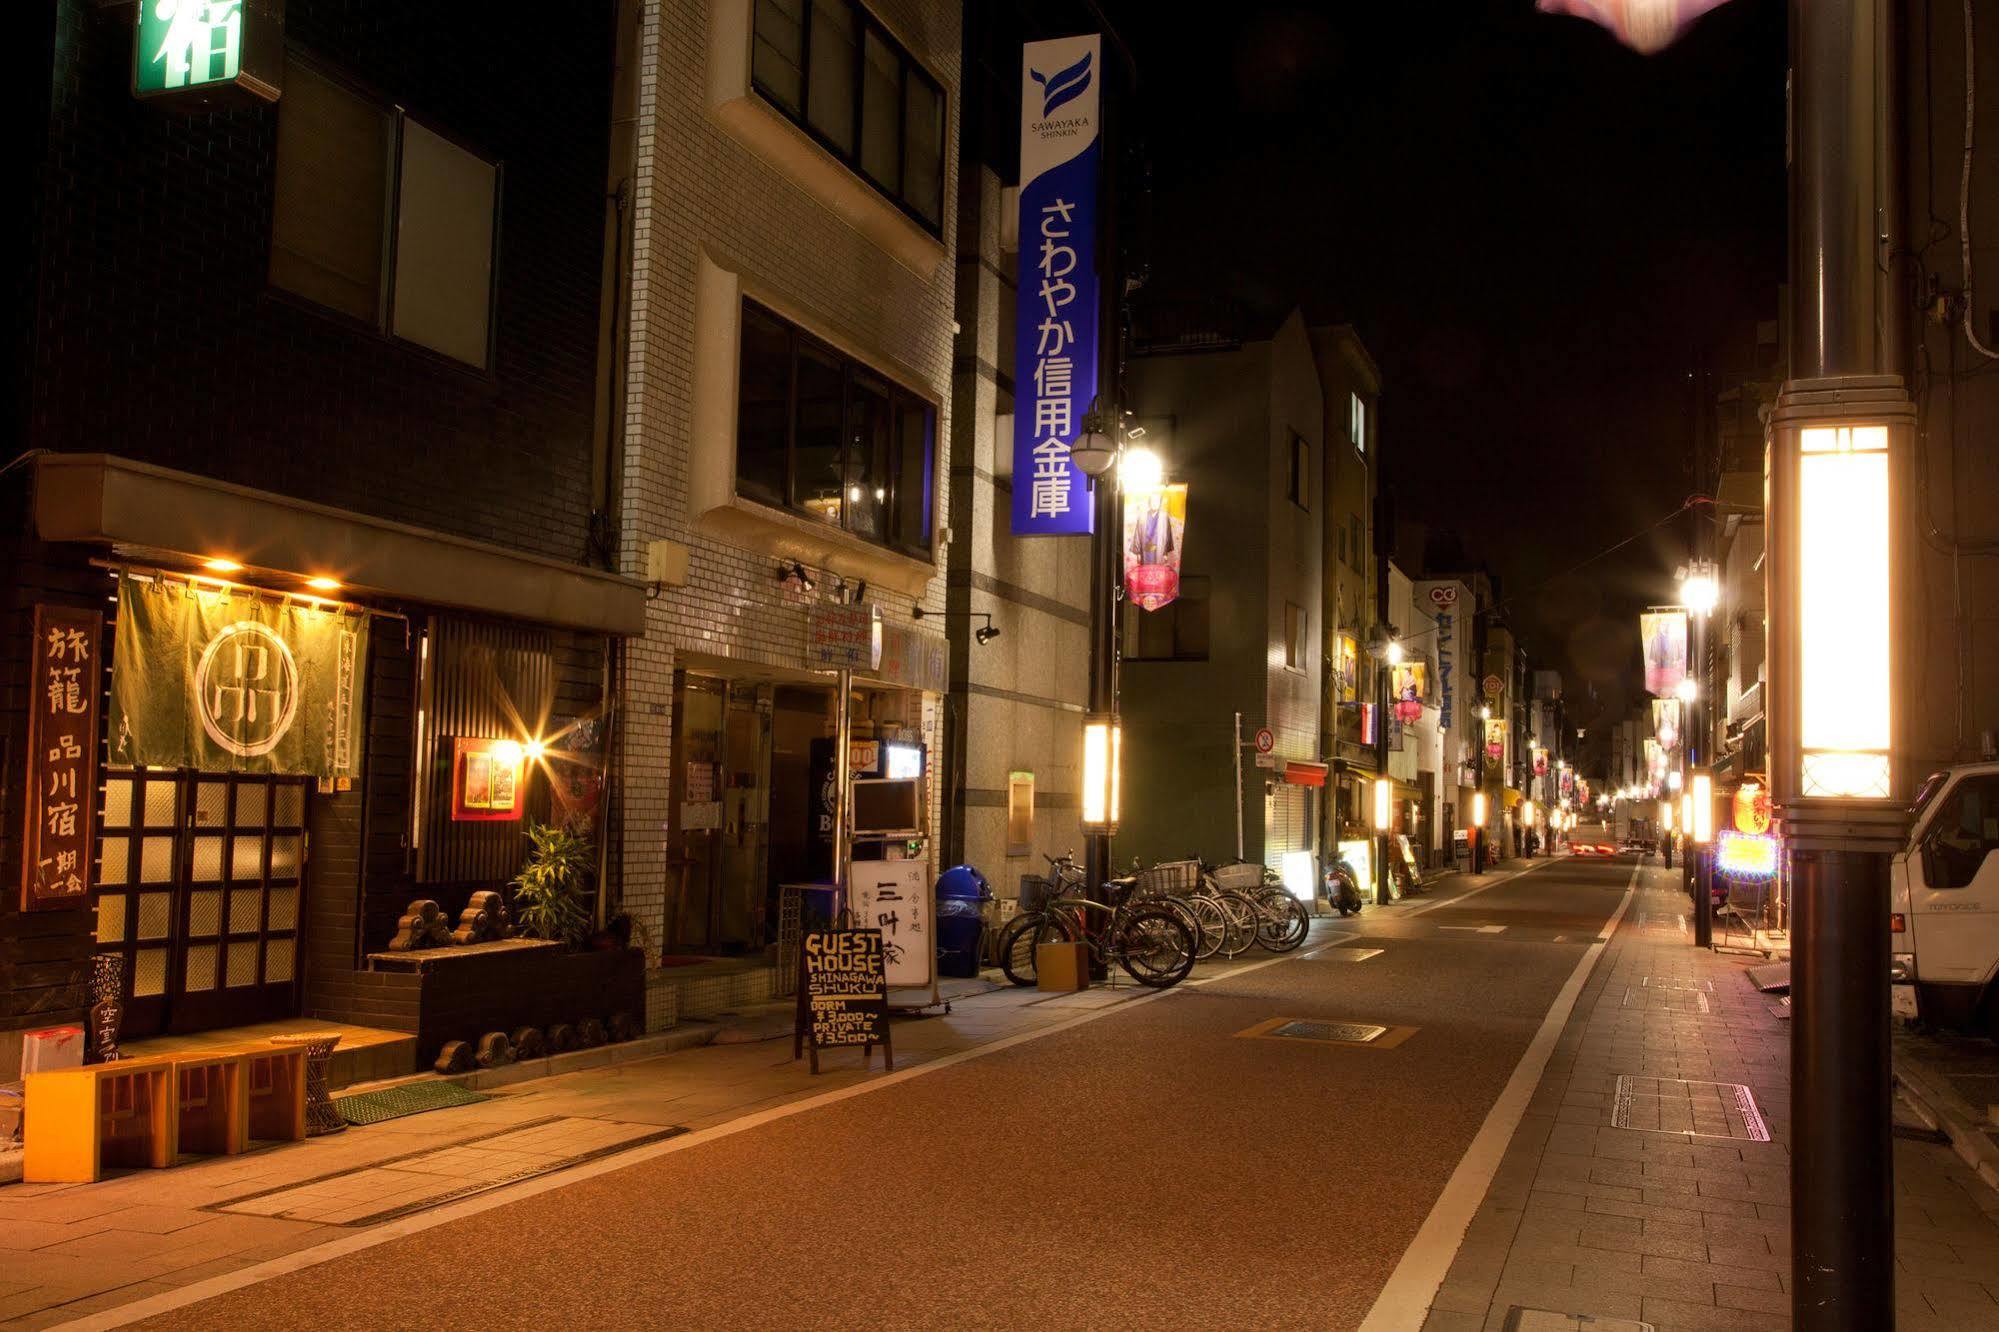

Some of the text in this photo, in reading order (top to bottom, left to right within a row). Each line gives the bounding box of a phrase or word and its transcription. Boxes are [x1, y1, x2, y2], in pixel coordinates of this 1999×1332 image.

[1031, 117, 1089, 133] SAWAYAKA
[1041, 128, 1078, 140] SHINKIN
[1030, 198, 1078, 519] さわやか信用金庫
[47, 627, 90, 715] 旅籠
[47, 734, 83, 838] 品川宿
[805, 932, 881, 956] GUEST
[806, 954, 881, 974] HOUSE
[810, 972, 885, 985] SHINAGAWA
[808, 982, 877, 995] SHUKU
[810, 1000, 846, 1011] DORM
[813, 1021, 873, 1033] PRIVATE
